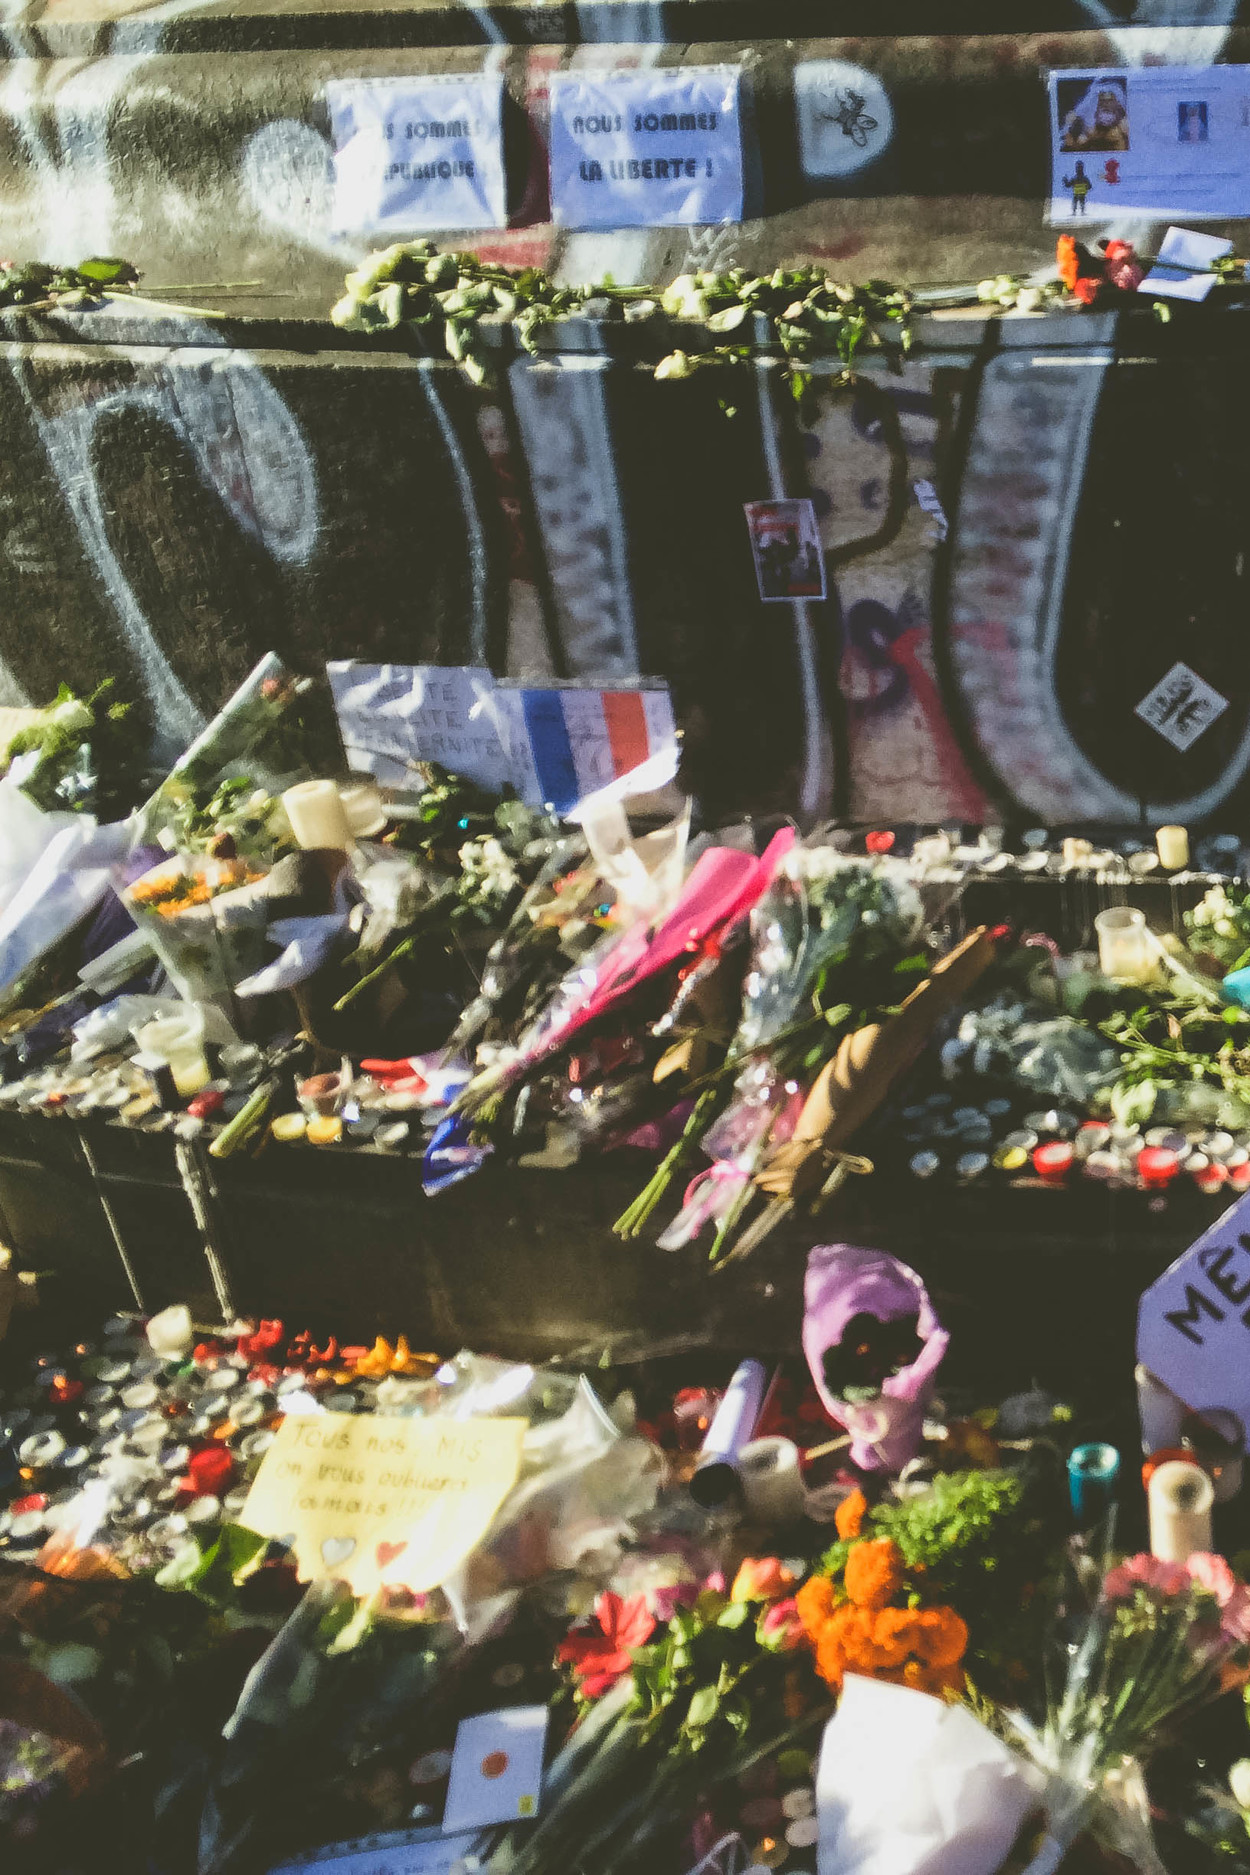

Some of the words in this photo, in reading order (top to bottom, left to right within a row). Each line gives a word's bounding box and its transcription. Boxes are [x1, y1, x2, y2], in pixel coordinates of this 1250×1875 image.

[573, 115, 622, 133] NOUS
[635, 112, 717, 132] SOMMES
[579, 159, 603, 181] LA
[609, 157, 697, 180] LIBERTE
[705, 156, 713, 179] !
